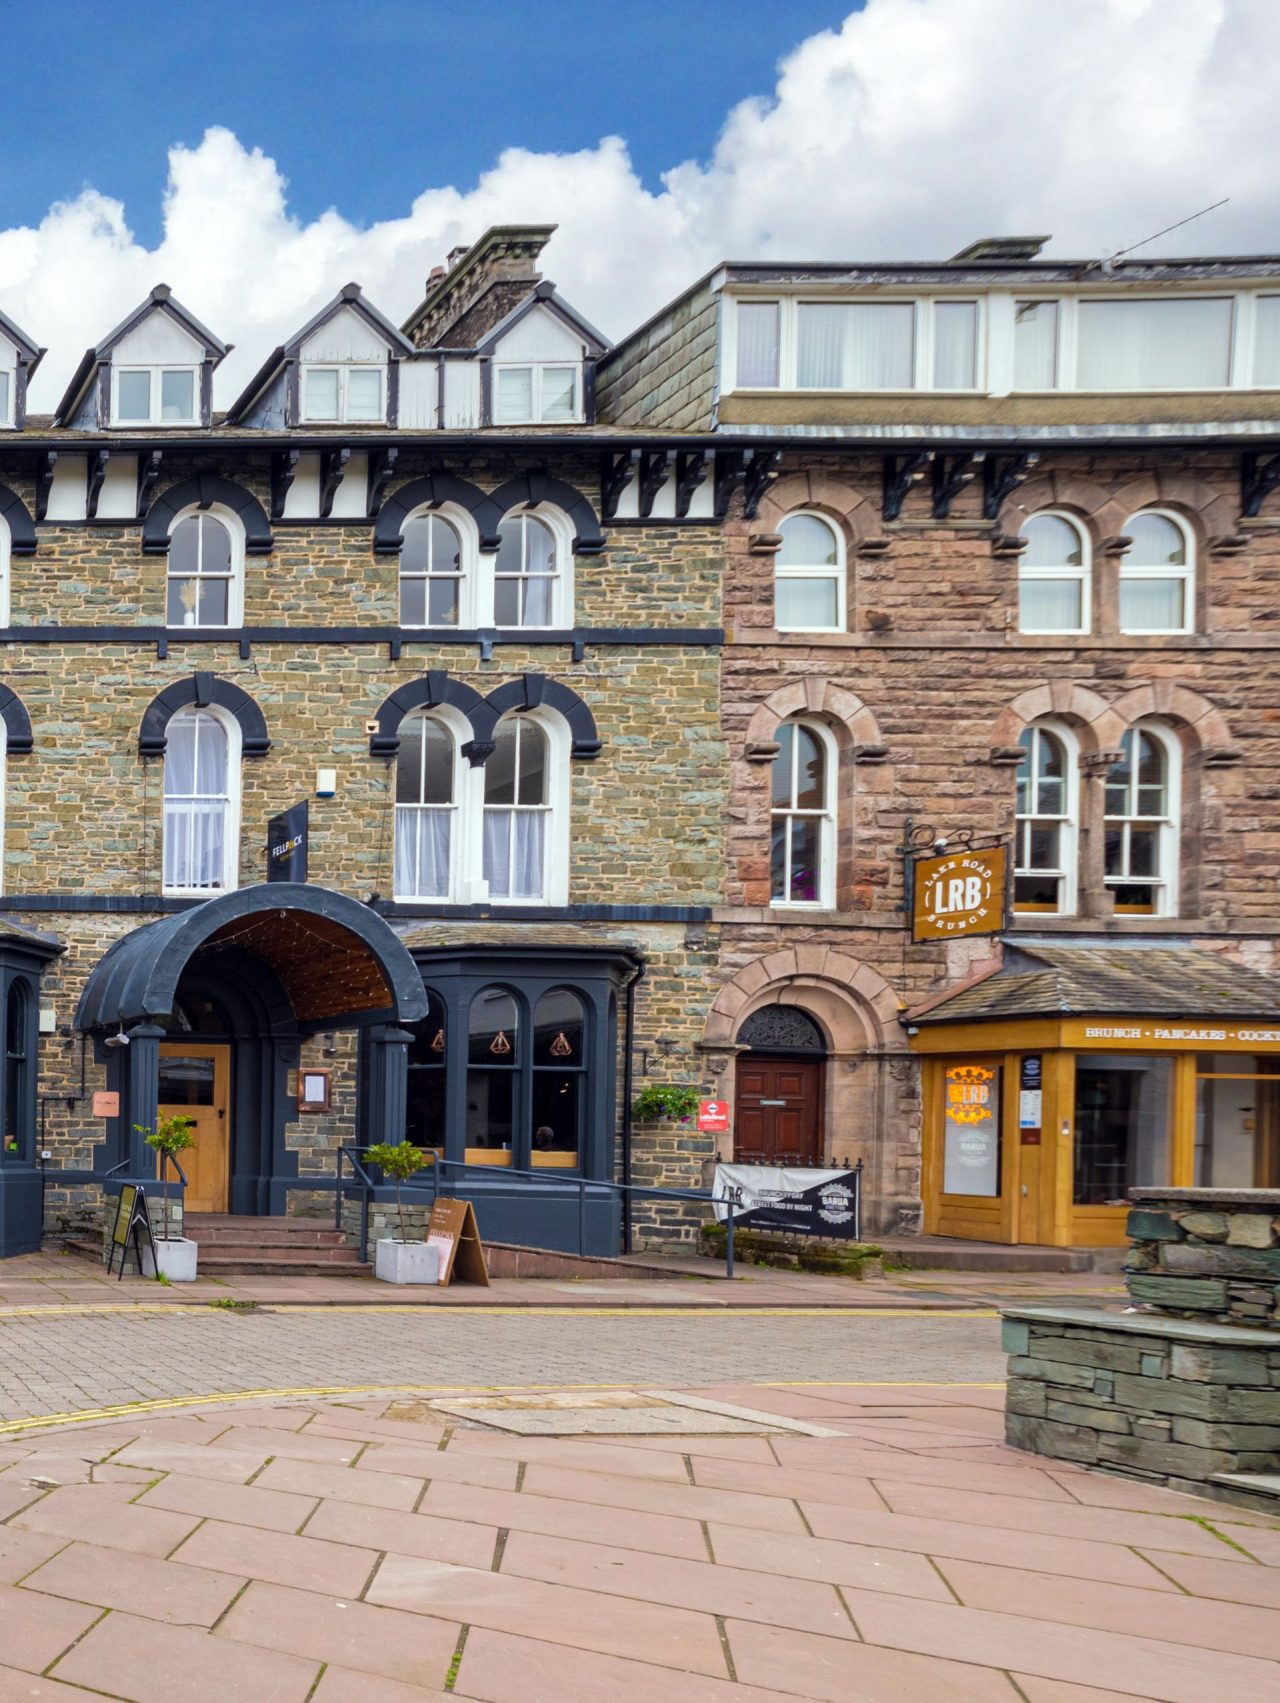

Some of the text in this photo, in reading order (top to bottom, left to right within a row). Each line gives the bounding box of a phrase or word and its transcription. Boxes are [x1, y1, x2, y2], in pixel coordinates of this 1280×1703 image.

[272, 833, 303, 858] FELLPACK
[924, 859, 992, 887] LAKE ROAD
[935, 876, 982, 914] LRB
[927, 908, 988, 930] BRUNCH
[1085, 1027, 1141, 1039] BRUNCH
[1153, 1028, 1226, 1041] PANCAKES
[962, 1084, 989, 1104] LRB
[771, 1201, 786, 1210] FOOD
[786, 1202, 794, 1211] BY
[794, 1203, 813, 1212] NIGHT
[822, 1196, 849, 1207] BARUA
